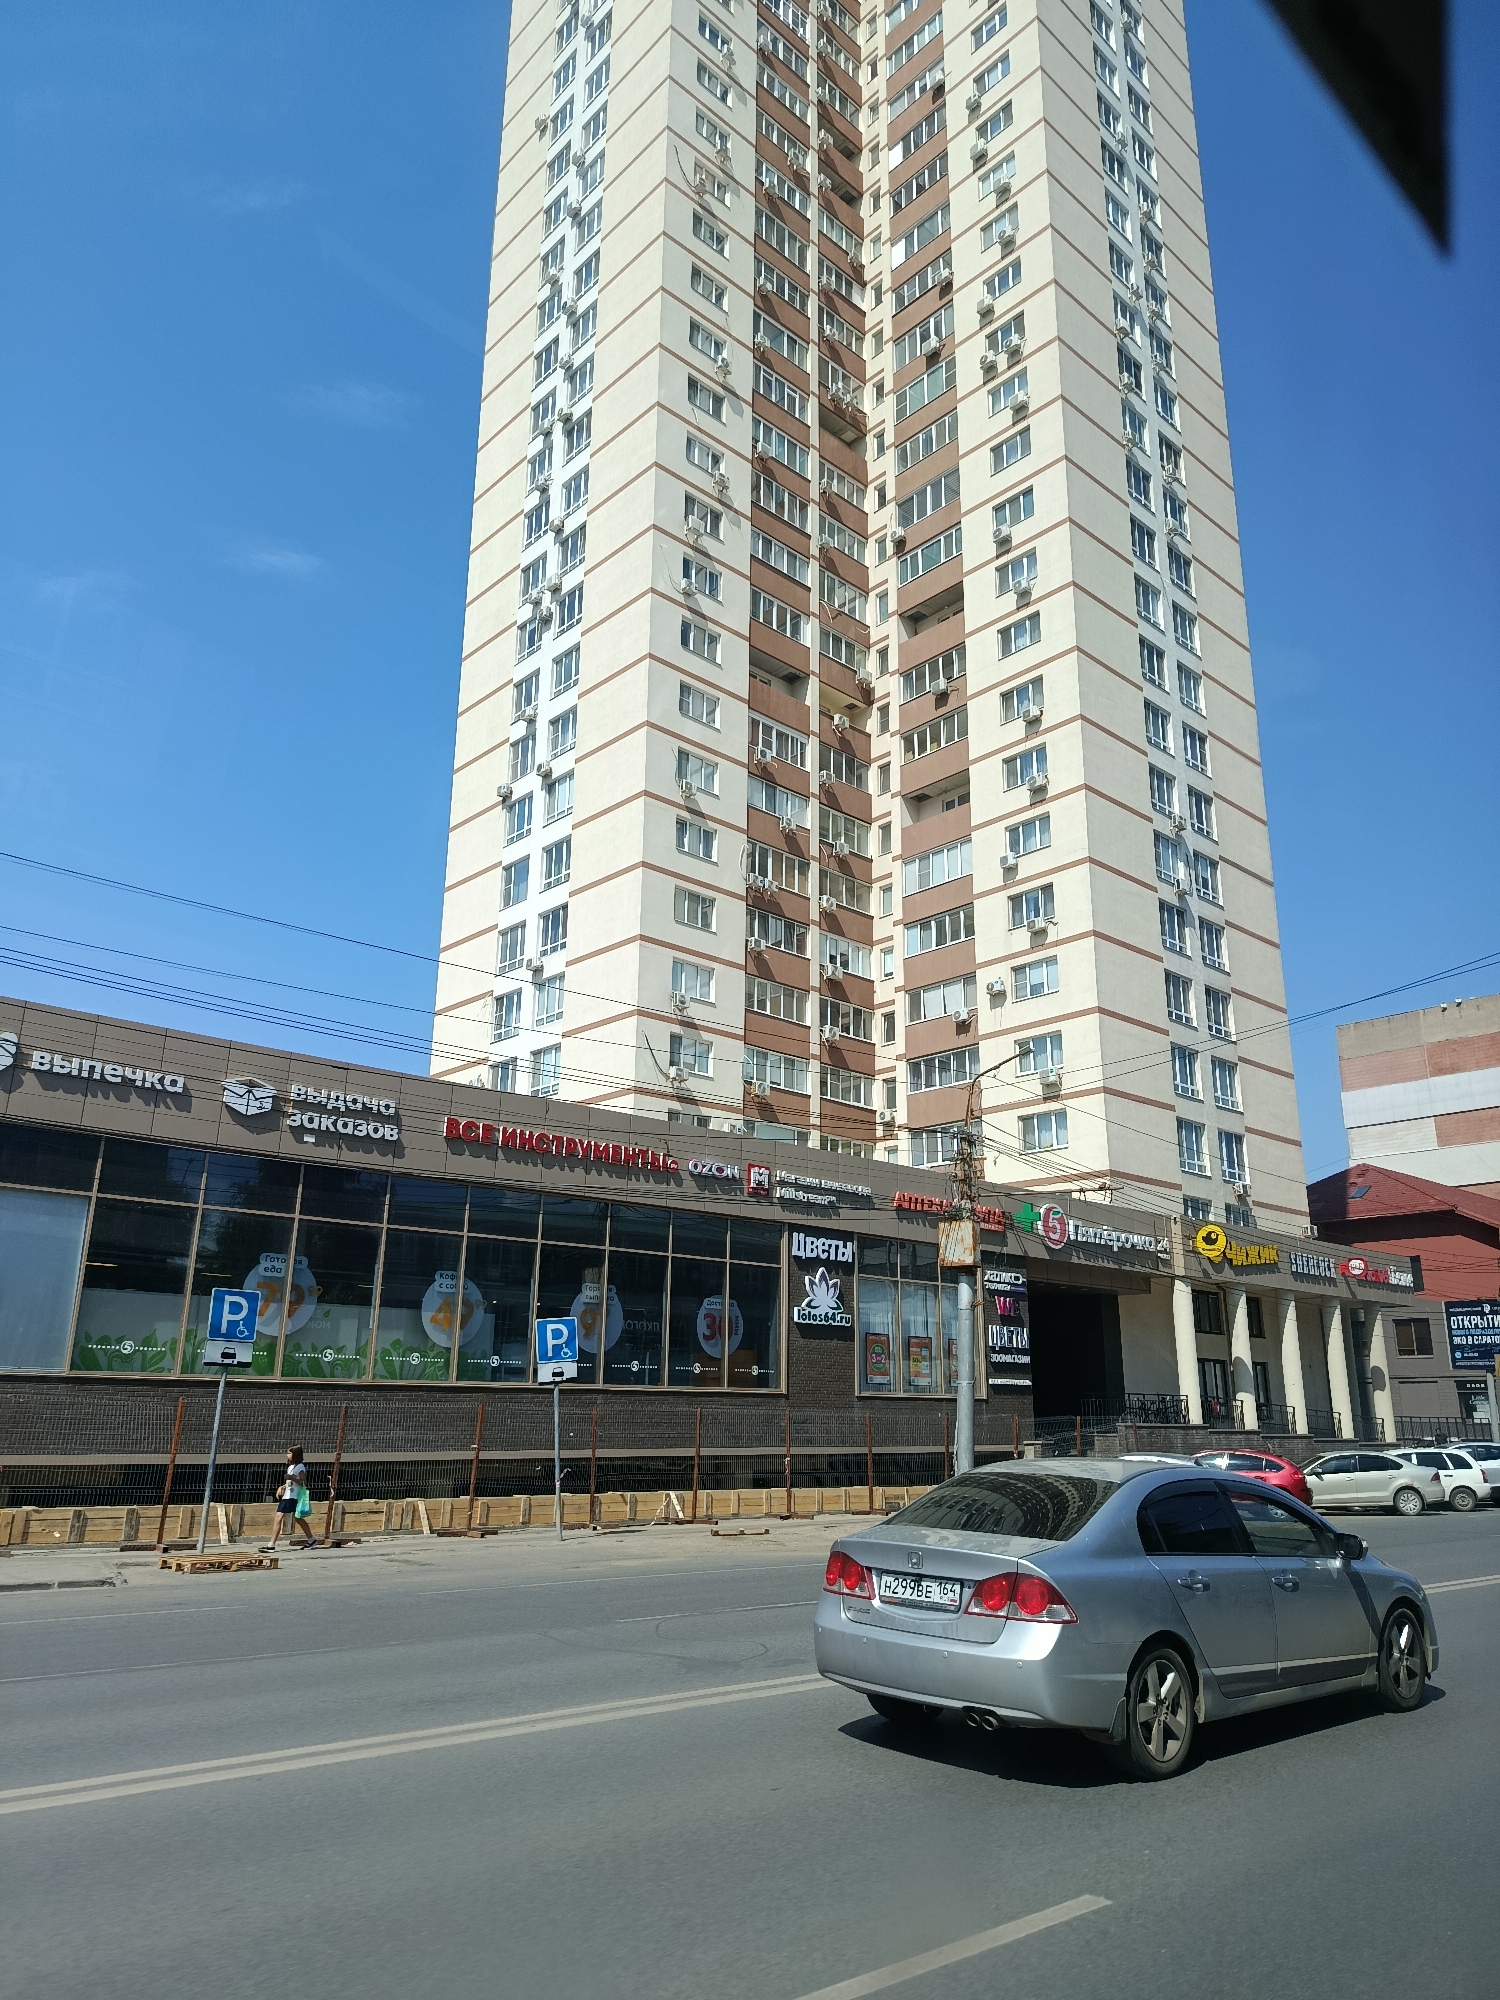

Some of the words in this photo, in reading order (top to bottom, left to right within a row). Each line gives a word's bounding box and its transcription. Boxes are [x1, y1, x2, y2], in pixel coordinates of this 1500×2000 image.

[444, 1116, 494, 1145] ВСЕ
[499, 1125, 668, 1172] ИНСТРУМЕНТЫ
[1068, 1219, 1156, 1251] Пятёрочка
[440, 1272, 458, 1282] Коф
[989, 1325, 1030, 1350] ЦВЕТЫ
[936, 1581, 956, 1597] 164
